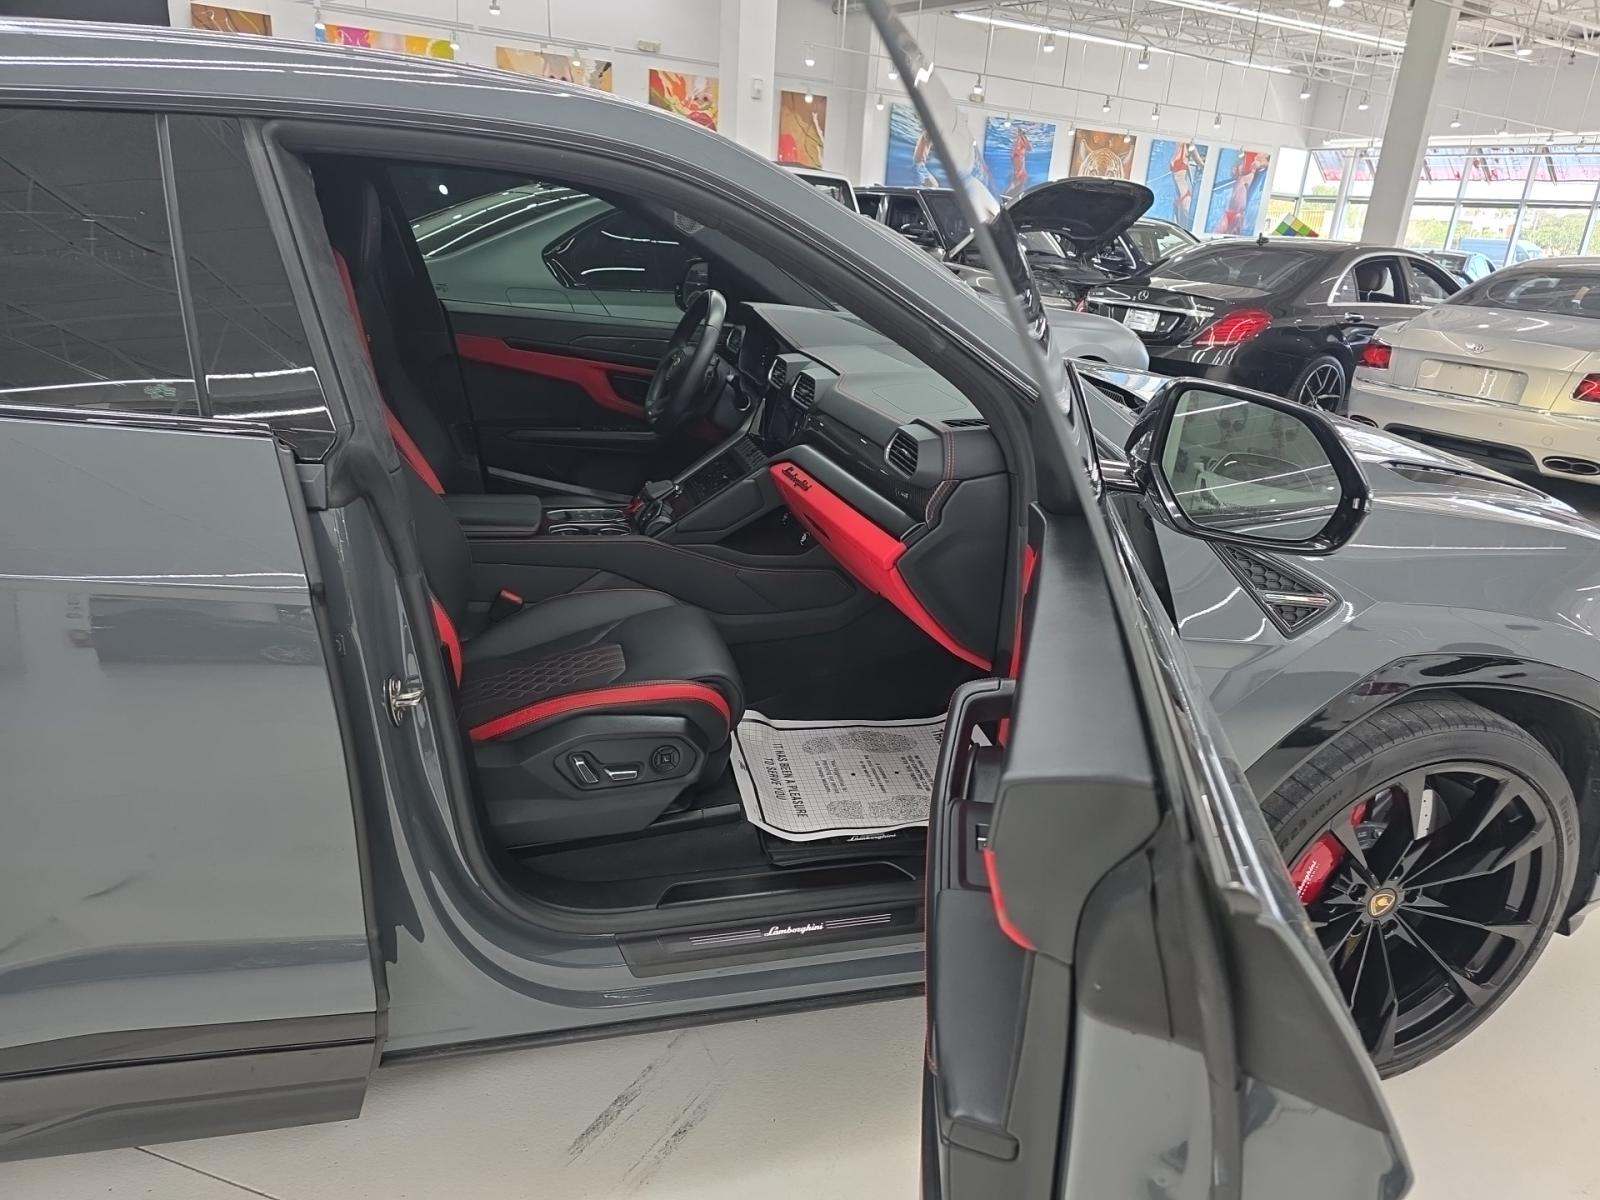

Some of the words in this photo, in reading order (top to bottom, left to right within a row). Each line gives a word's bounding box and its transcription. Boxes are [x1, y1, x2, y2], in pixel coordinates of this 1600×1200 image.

[763, 758, 775, 767] TO
[775, 750, 788, 762] HAS
[766, 766, 782, 786] SERVE
[780, 762, 793, 780] BEEN
[774, 786, 787, 801] YOU
[788, 785, 809, 818] PLEASURE
[763, 922, 824, 937] Lamborghini
